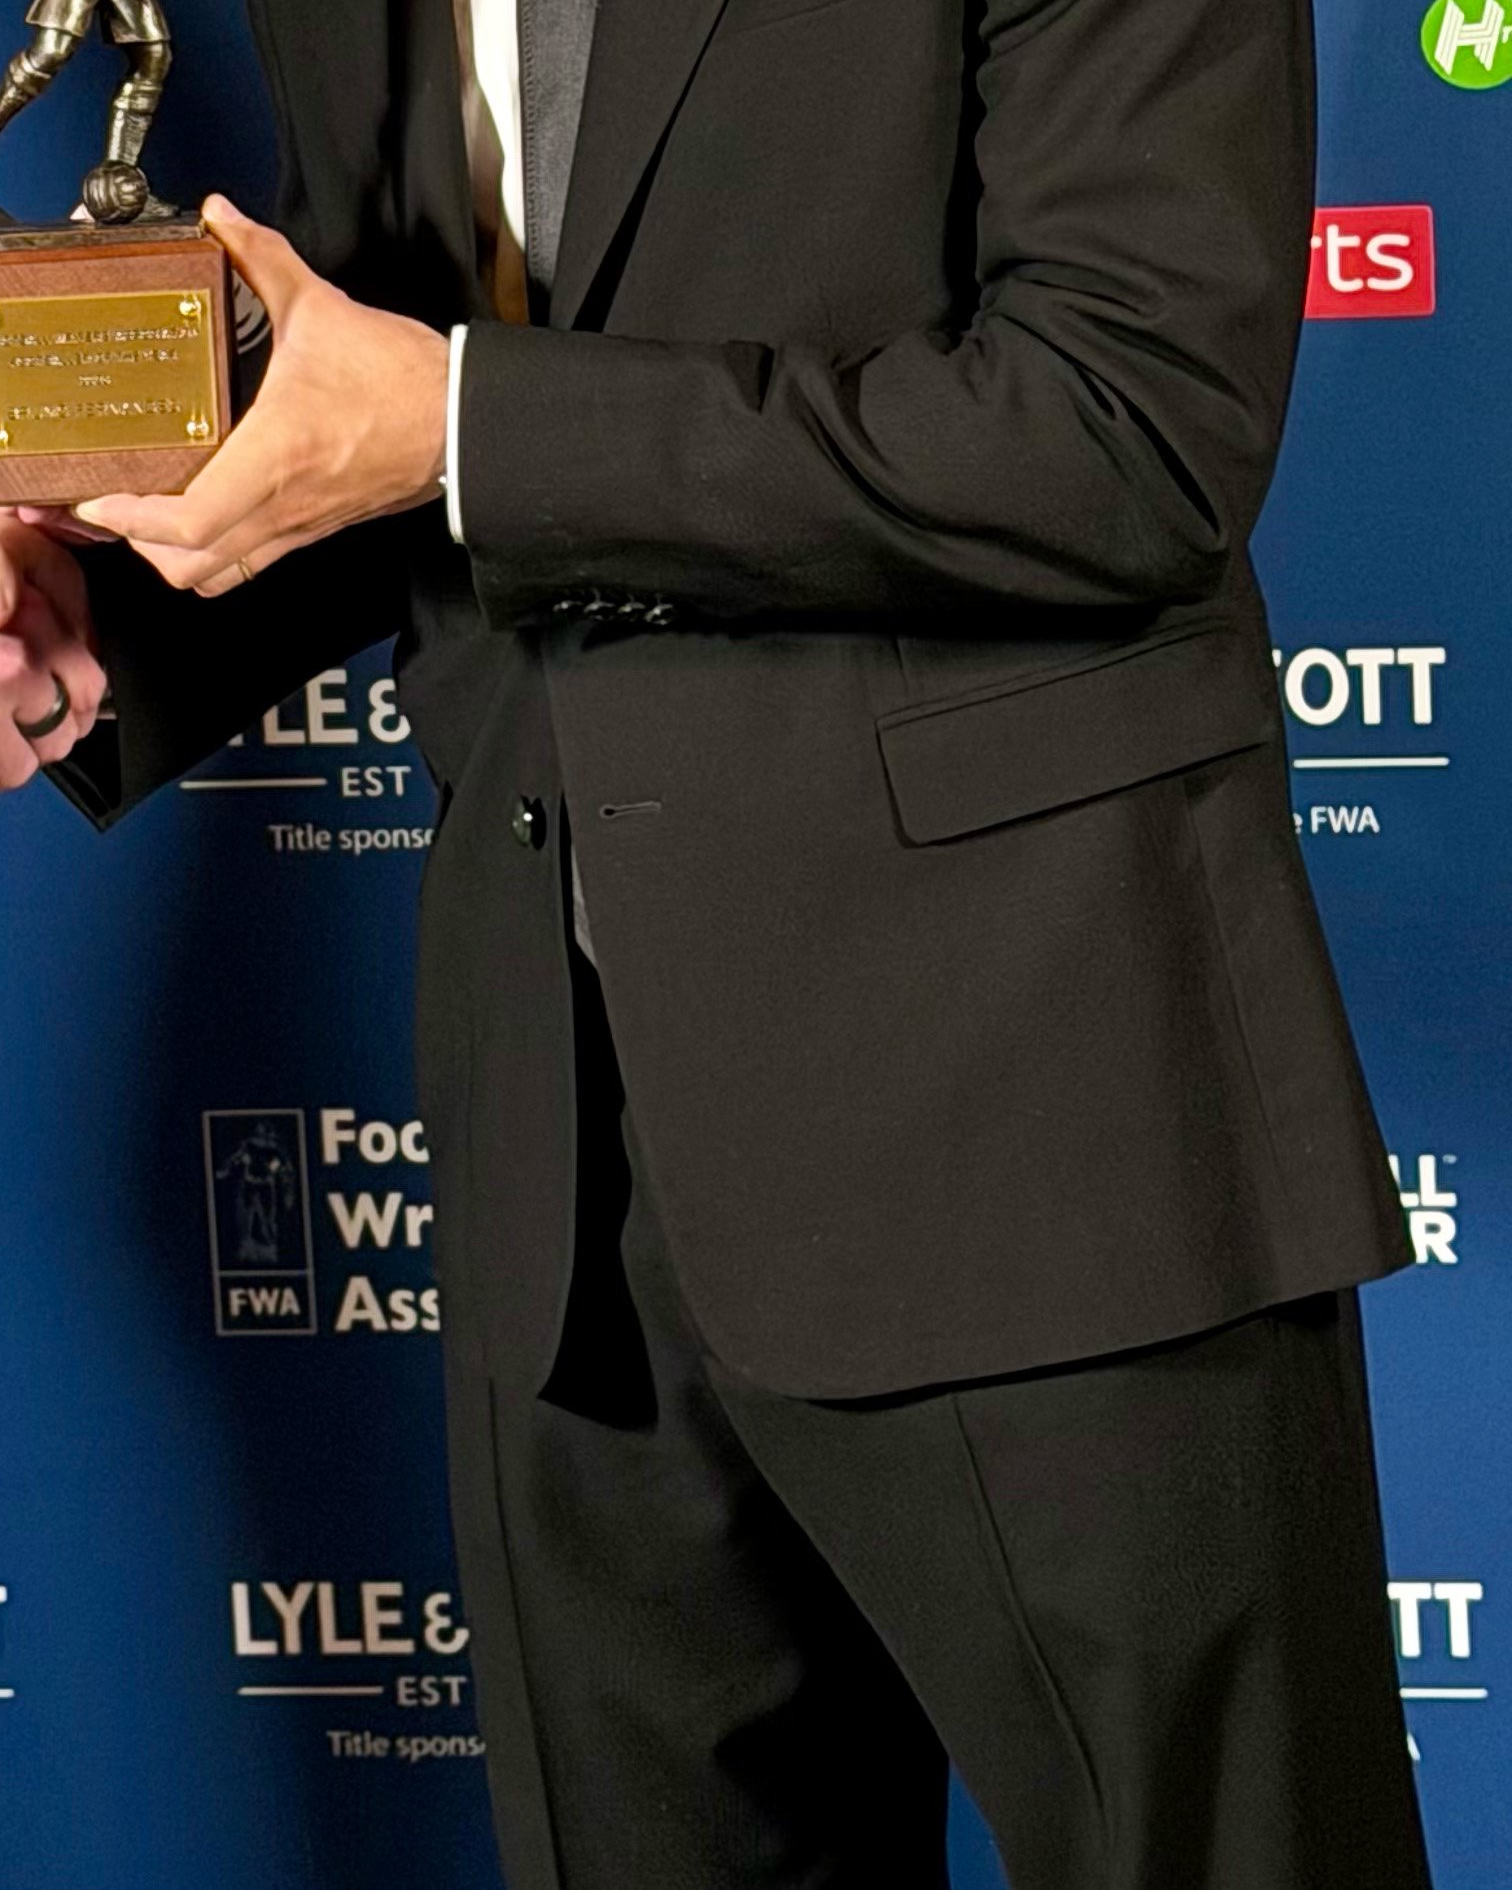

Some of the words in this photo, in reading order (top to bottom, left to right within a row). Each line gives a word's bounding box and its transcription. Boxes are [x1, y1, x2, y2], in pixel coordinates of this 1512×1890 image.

[1271, 647, 1446, 726] OTT
[227, 668, 359, 745] LE
[341, 765, 411, 797] EST
[1310, 806, 1380, 833] FWA
[269, 823, 333, 851] Title
[230, 1288, 300, 1315] FWA
[231, 1582, 415, 1656] LYLE
[398, 1676, 466, 1705] EST
[327, 1731, 389, 1756] Title
[396, 1736, 487, 1762] spons
